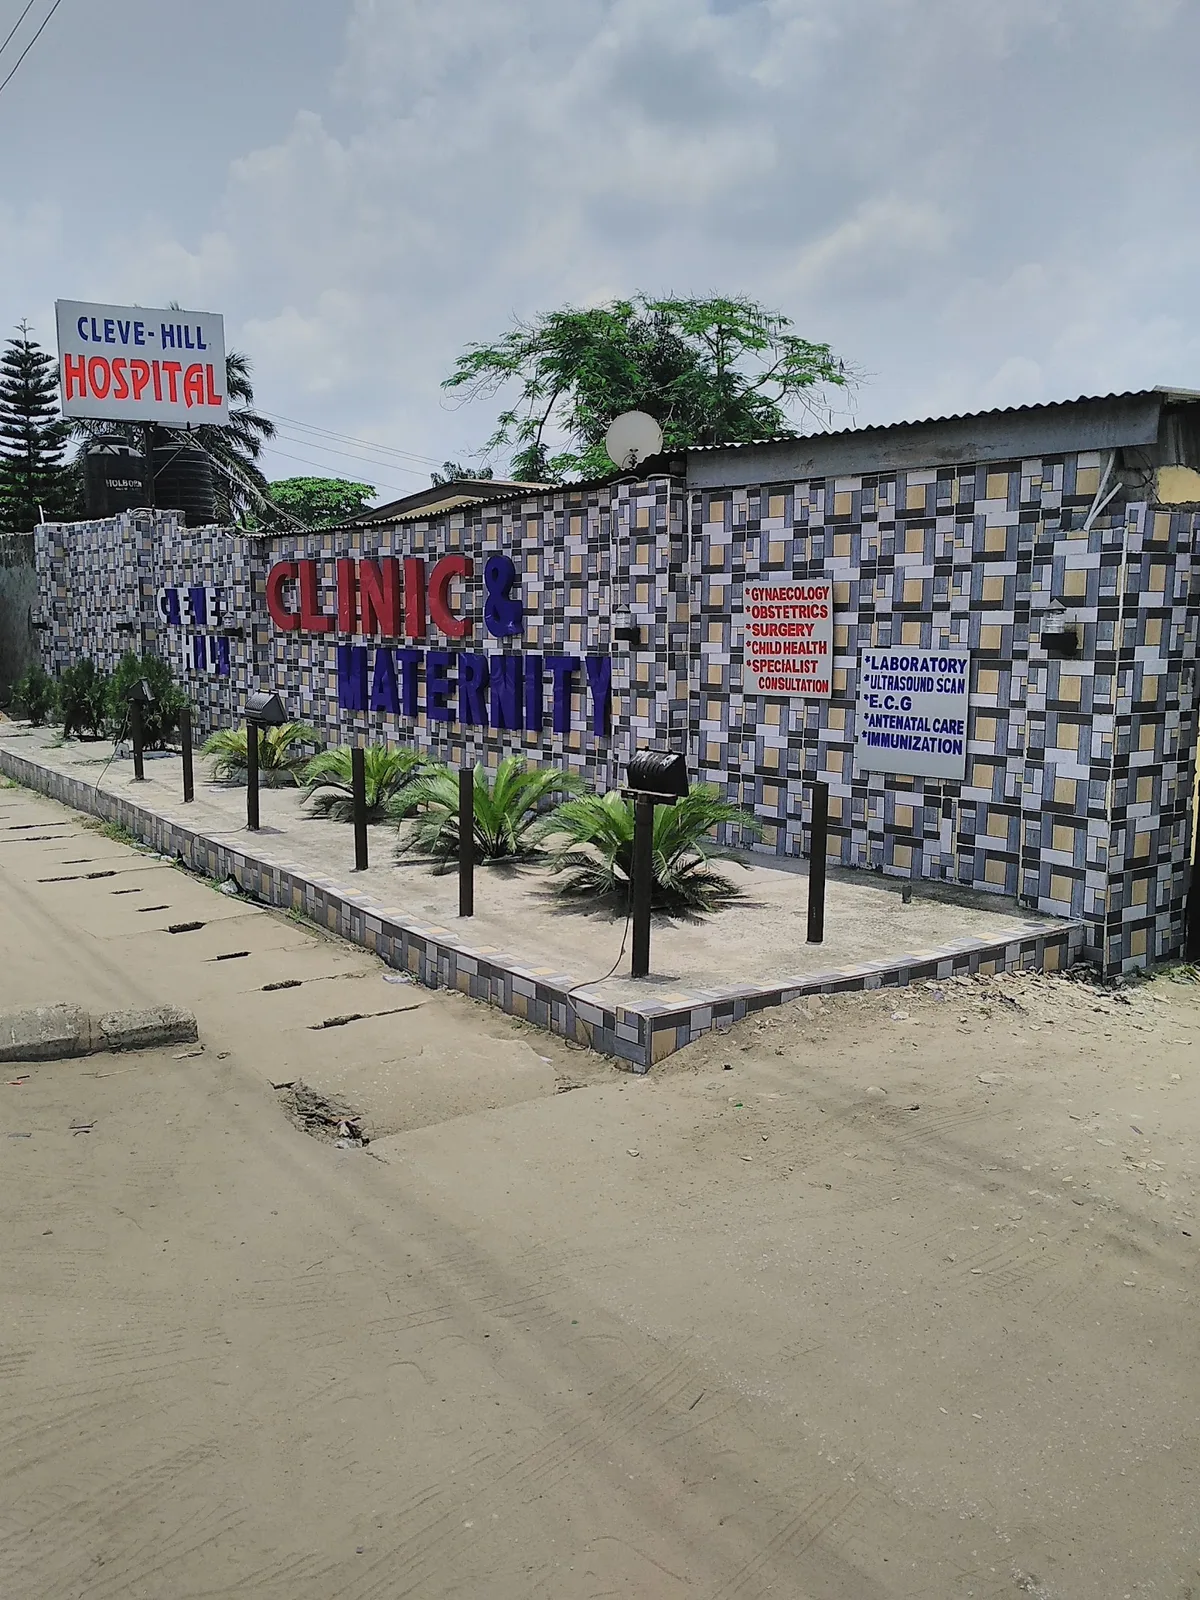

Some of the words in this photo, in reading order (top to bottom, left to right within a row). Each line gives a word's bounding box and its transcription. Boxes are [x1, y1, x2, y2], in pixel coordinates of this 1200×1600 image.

[64, 353, 223, 408] HOSPITAL
[266, 555, 474, 637] CLINIC
[484, 555, 525, 637] &
[751, 586, 830, 601] GYNAECOLOGY
[751, 604, 828, 619] OBSTETRICS
[752, 623, 814, 636] SURGERY
[751, 641, 782, 654] CHILD
[783, 641, 827, 654] HEALTH
[752, 659, 818, 673] SPECIALIST
[871, 656, 967, 674] LABORATORY
[337, 644, 613, 738] MATERNITY
[758, 676, 829, 692] CONSULTATION
[870, 674, 934, 692] ULTRASOUND
[936, 678, 965, 694] SCAN
[869, 694, 912, 711] E.C.G
[868, 713, 930, 732] ANTENATAL
[933, 718, 964, 735] CARE
[867, 731, 963, 755] IMMUNIZATION
